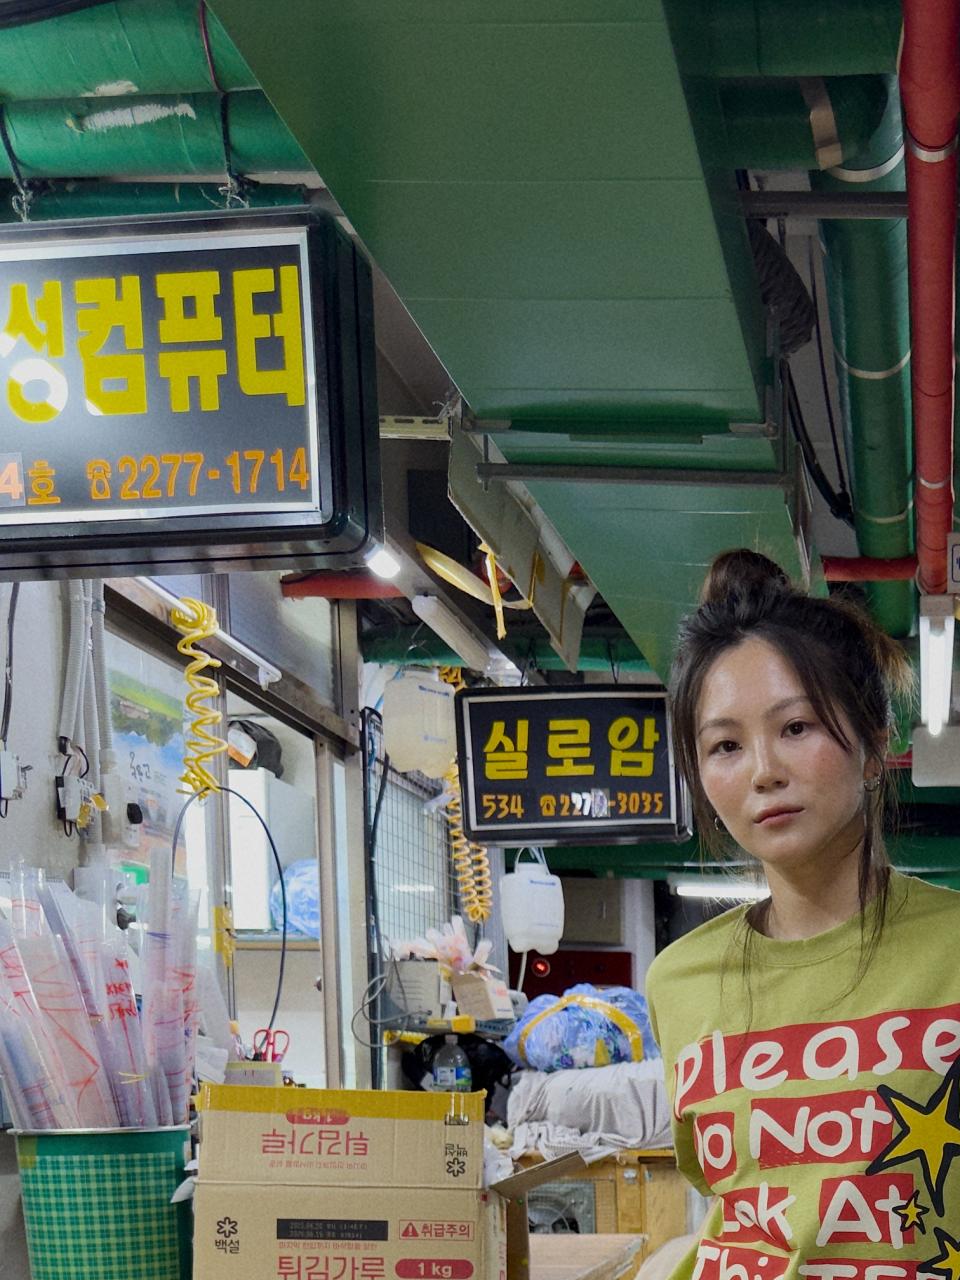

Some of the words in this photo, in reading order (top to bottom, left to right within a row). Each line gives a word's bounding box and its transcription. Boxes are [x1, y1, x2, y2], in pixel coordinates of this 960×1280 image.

[118, 447, 310, 499] 2277-1714
[483, 716, 660, 780] 실로암
[482, 793, 525, 818] 534
[262, 1128, 370, 1156] 튀김가루
[751, 1096, 893, 1160] Not
[815, 1180, 910, 1250] At
[420, 1222, 471, 1239] 취급주의
[214, 1239, 240, 1254] 백설
[432, 1261, 453, 1279] kg
